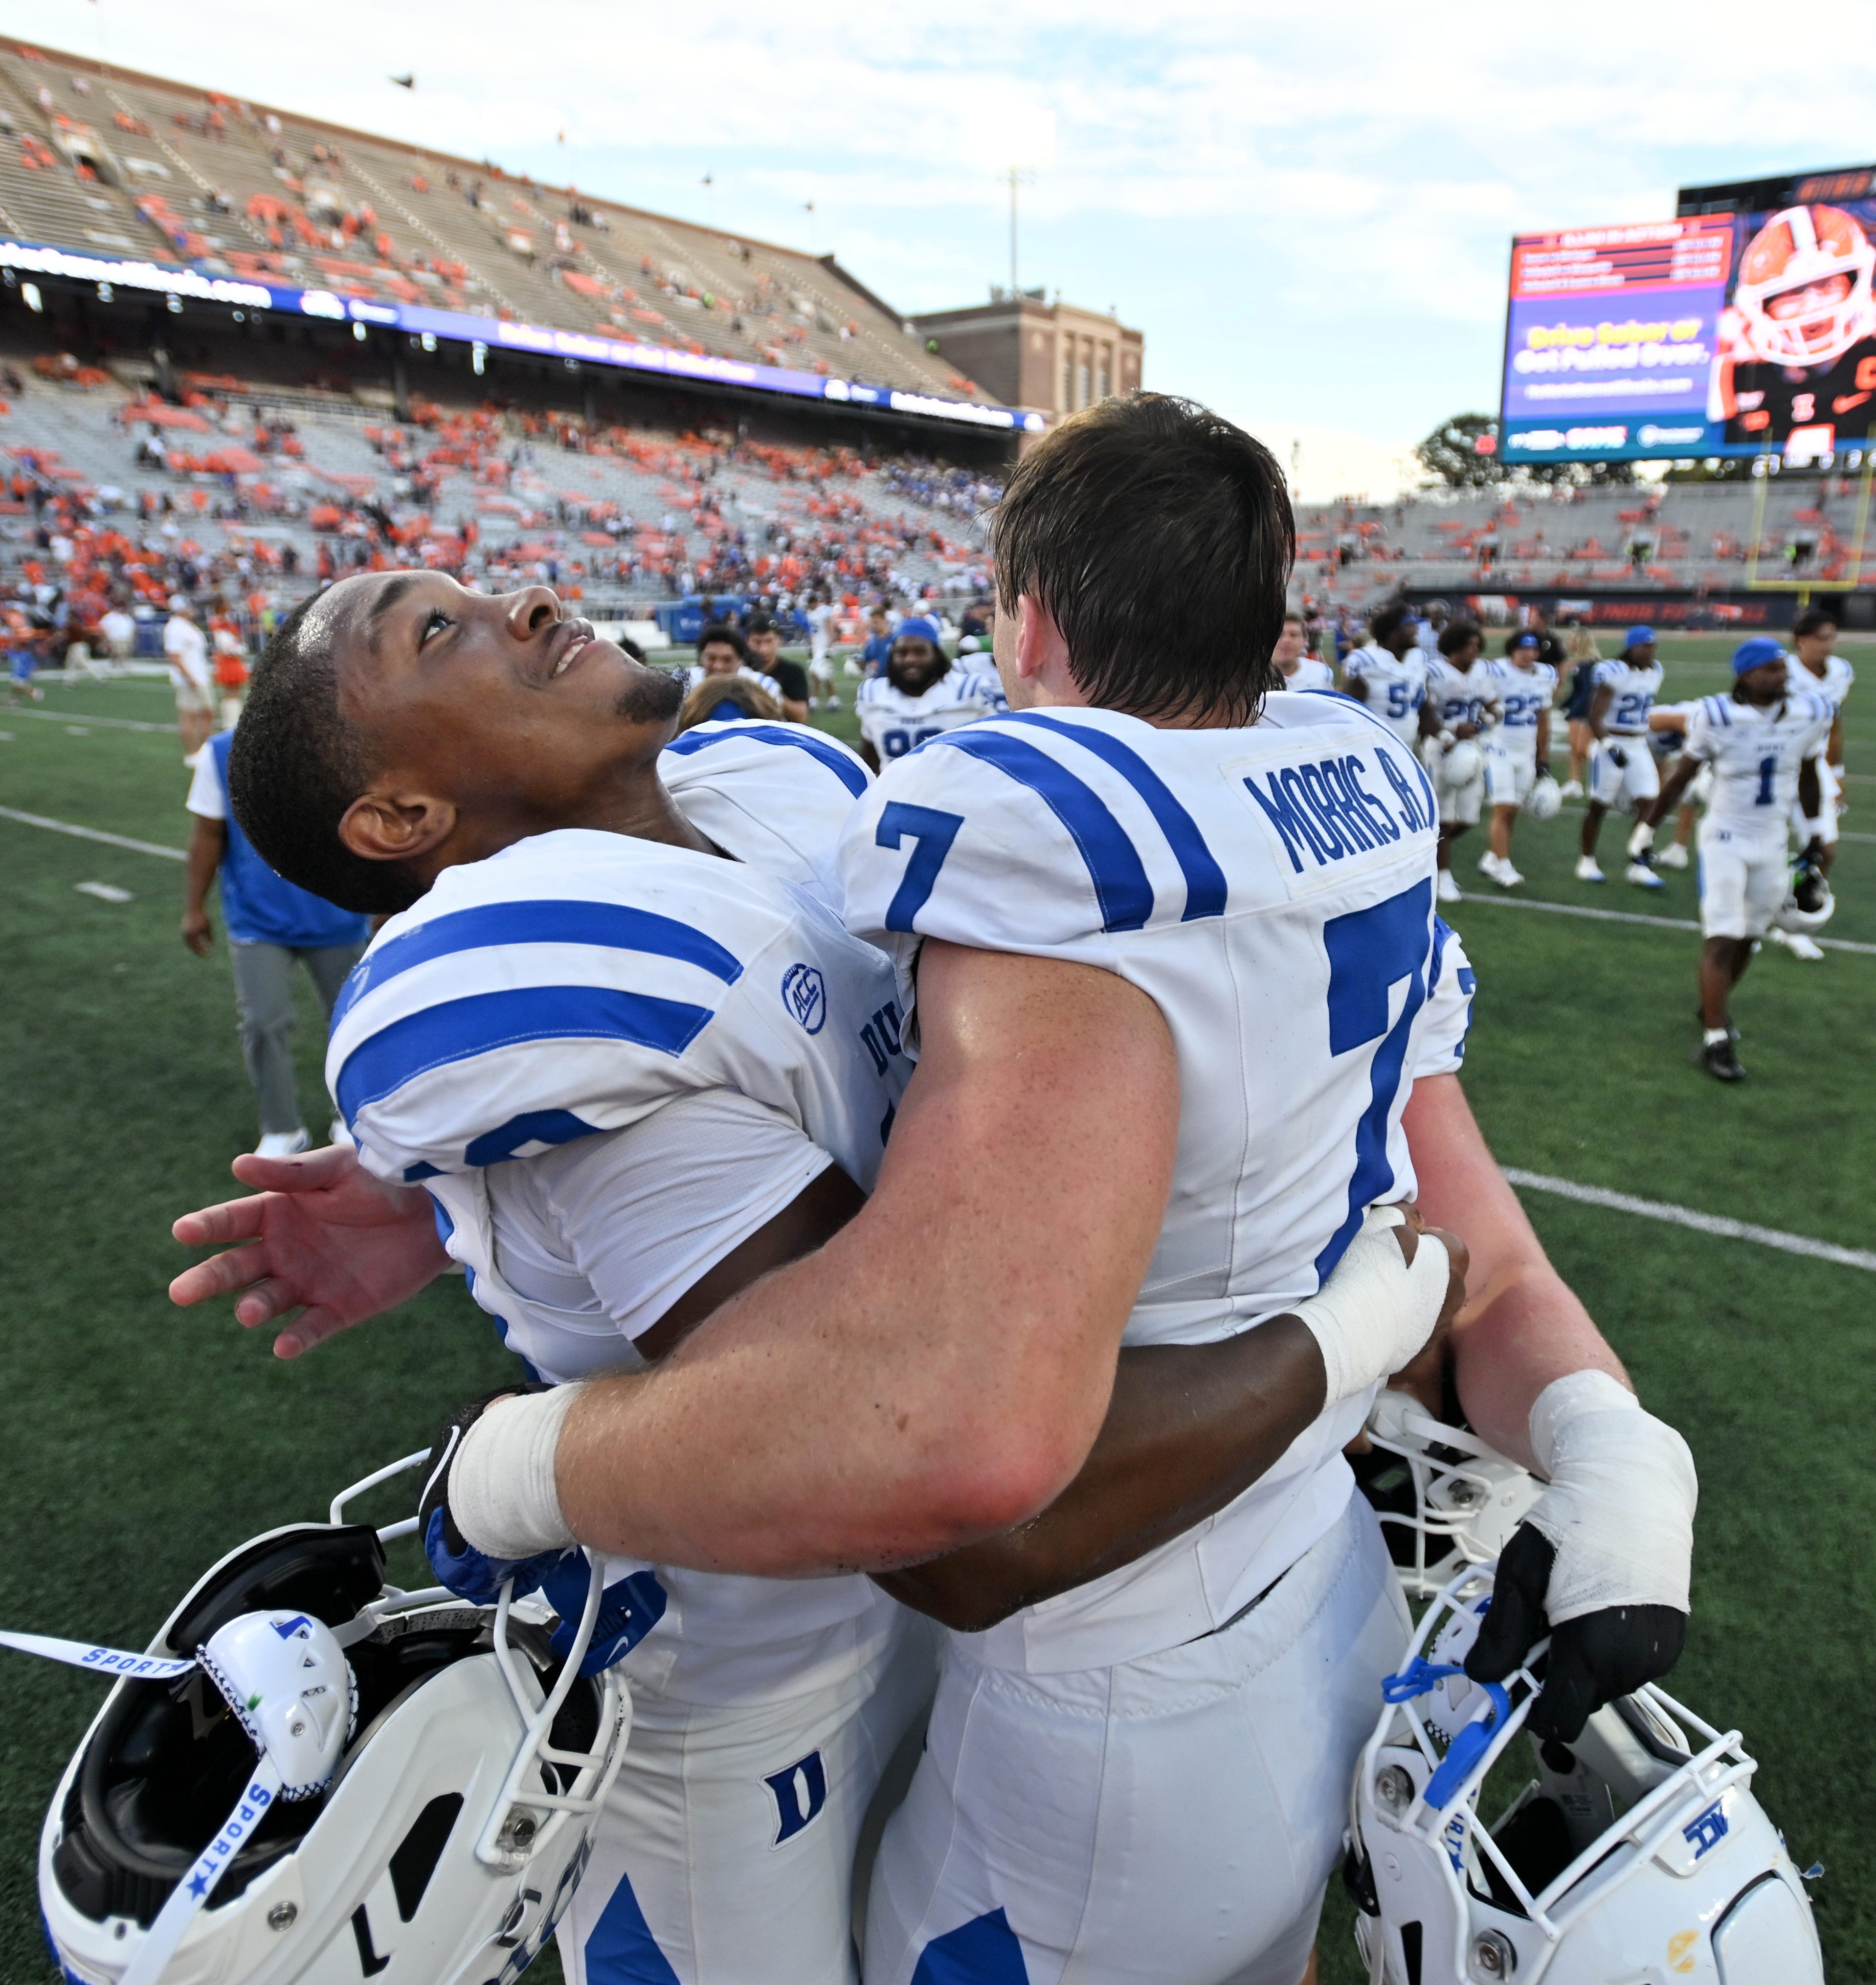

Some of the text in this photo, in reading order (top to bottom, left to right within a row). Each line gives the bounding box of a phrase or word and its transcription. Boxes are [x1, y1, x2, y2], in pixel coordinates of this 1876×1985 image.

[1243, 755, 1400, 874] MORRIS
[1755, 756, 1777, 805] 1
[876, 800, 965, 934] 7
[792, 969, 818, 1019] ACC
[859, 1000, 902, 1077] DU
[1314, 876, 1432, 1295] 7
[82, 1648, 170, 1674] SPORT
[203, 1783, 271, 1875] SPORT
